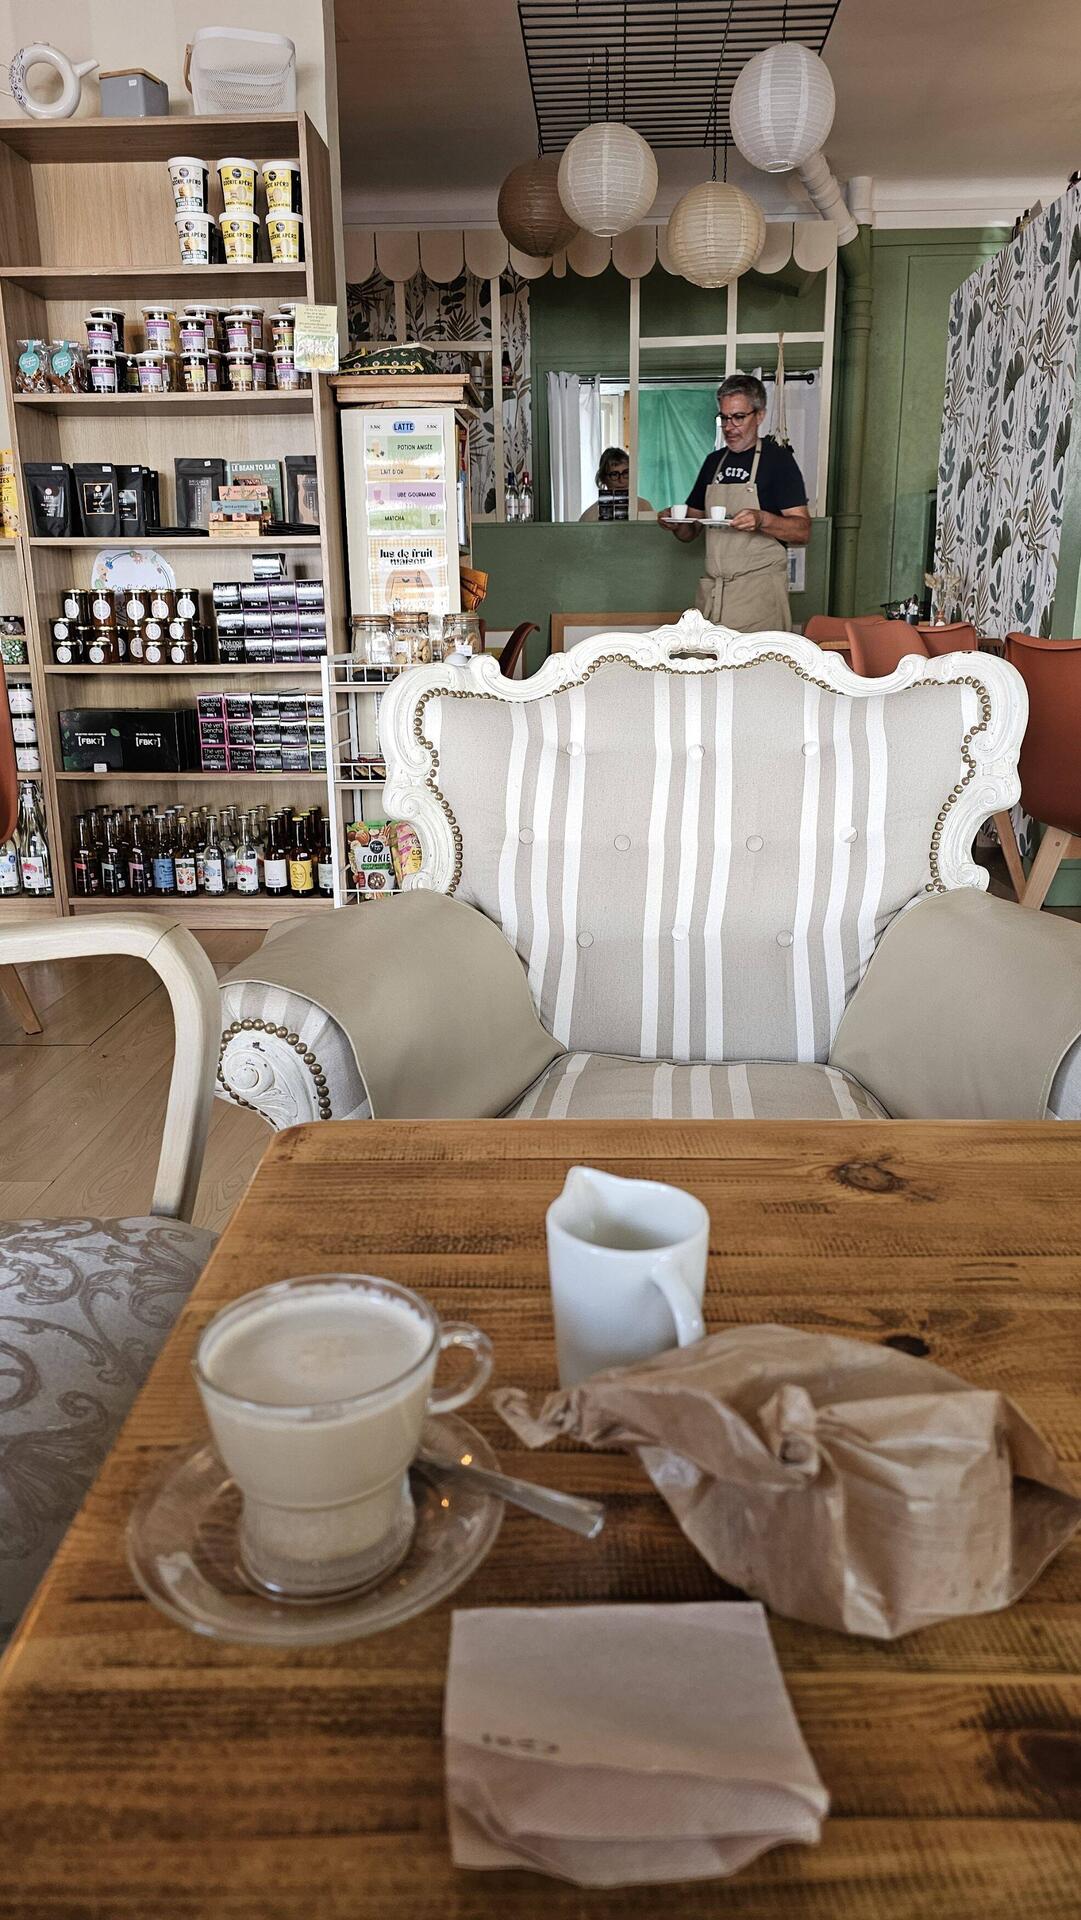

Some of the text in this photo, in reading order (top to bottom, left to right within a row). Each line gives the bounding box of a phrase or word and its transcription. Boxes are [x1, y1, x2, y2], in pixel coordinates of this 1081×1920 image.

[393, 423, 414, 431] LATTE
[231, 464, 238, 472] LE
[239, 464, 255, 472] BEAN
[725, 467, 750, 481] CITY
[397, 549, 409, 559] de
[411, 548, 433, 558] fruit
[390, 558, 425, 566] maison
[362, 853, 390, 863] COOKIE
